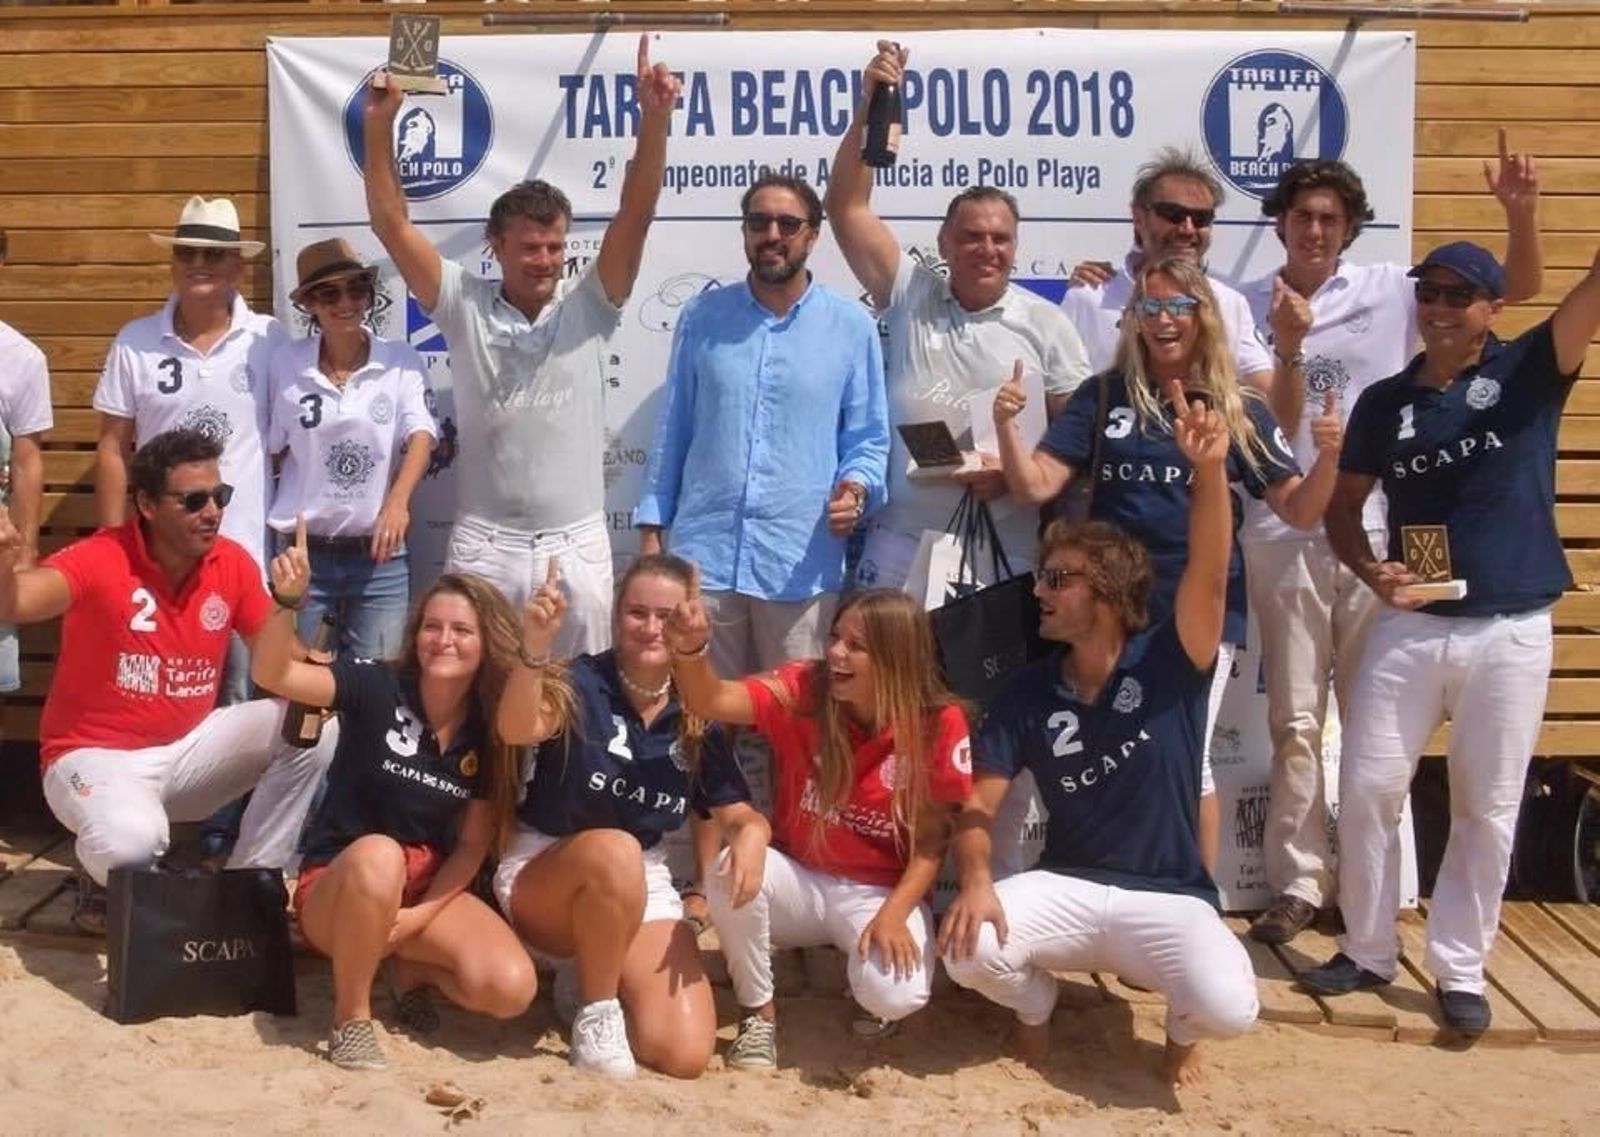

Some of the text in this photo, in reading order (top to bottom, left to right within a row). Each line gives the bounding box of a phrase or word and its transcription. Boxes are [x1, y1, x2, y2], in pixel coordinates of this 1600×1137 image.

[1229, 69, 1320, 83] TARIFA
[559, 71, 715, 138] TARA
[901, 68, 1010, 137] POLO
[1026, 70, 1134, 138] 2018
[422, 162, 463, 176] POLO
[625, 157, 771, 194] mpeonato
[816, 157, 933, 187] Alucia
[942, 158, 969, 187] de
[978, 158, 1028, 188] Polo
[1037, 159, 1101, 195] Playa
[1230, 161, 1278, 176] BEACH
[157, 357, 183, 394] 3
[300, 394, 323, 429] 3
[1105, 407, 1137, 440] 3
[1397, 403, 1416, 440] 1
[1393, 430, 1504, 479] SCAPA
[1101, 464, 1195, 486] SCAP
[130, 588, 158, 632] 2
[385, 705, 424, 757] 3
[1047, 710, 1084, 757] 2
[382, 759, 421, 782] SCAPA
[588, 771, 687, 814] SCAPA
[182, 939, 256, 962] SCAPA
